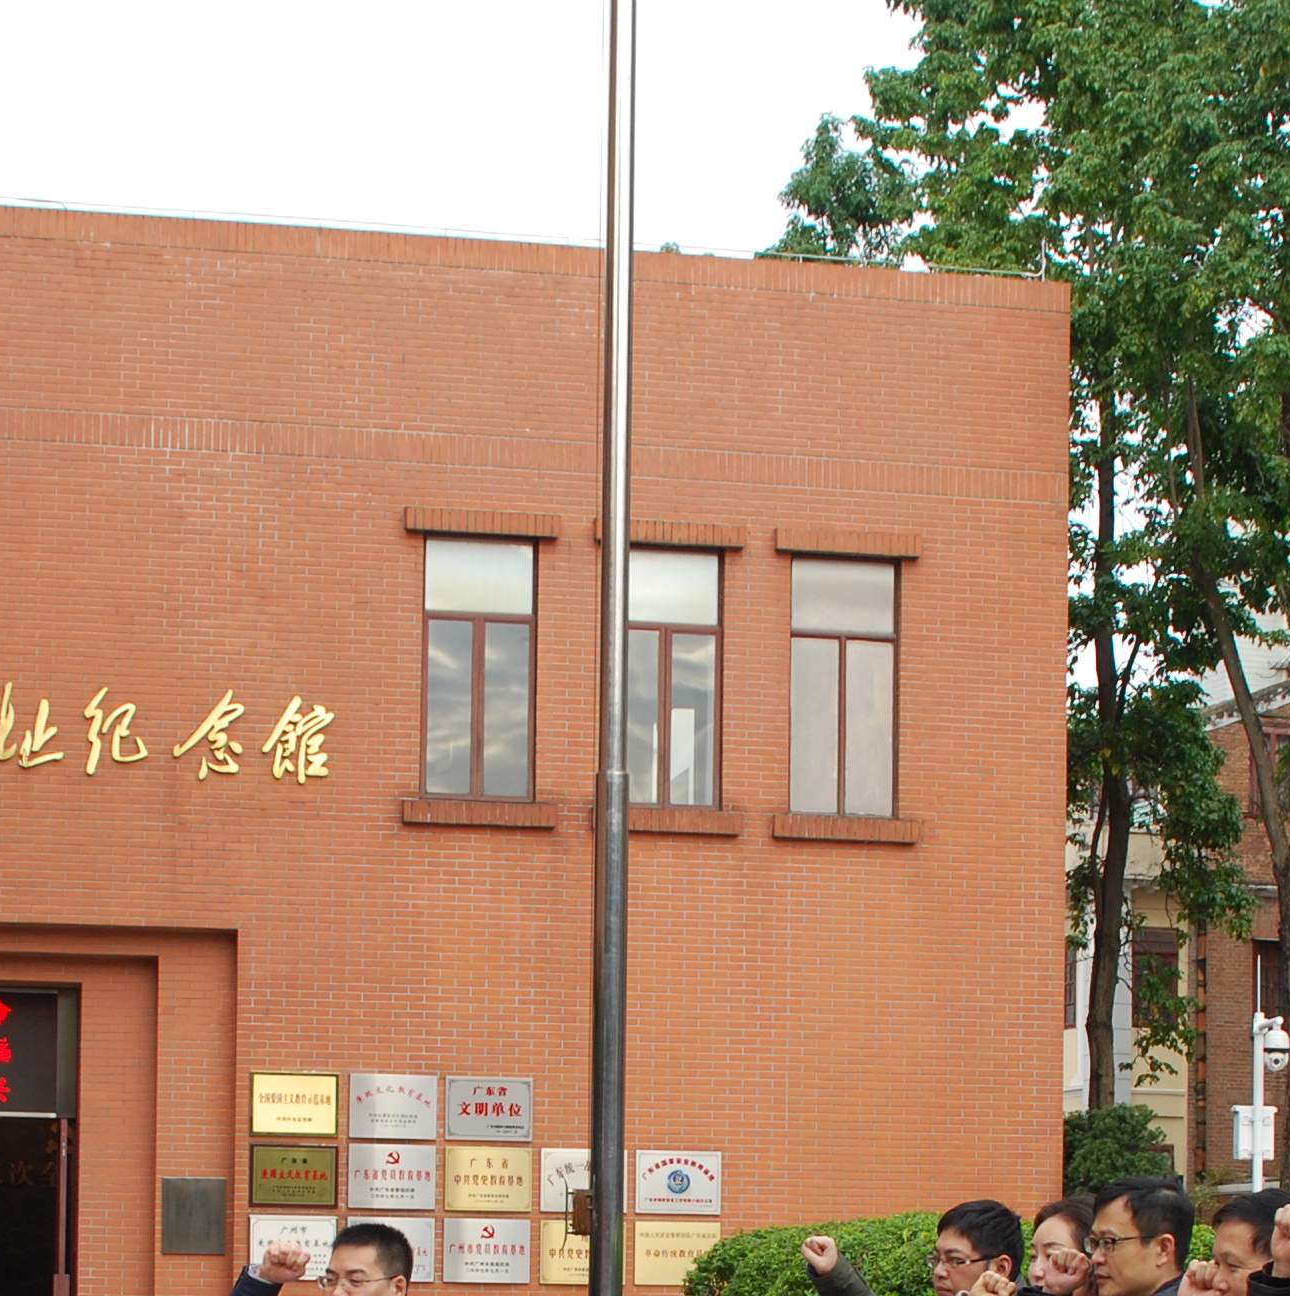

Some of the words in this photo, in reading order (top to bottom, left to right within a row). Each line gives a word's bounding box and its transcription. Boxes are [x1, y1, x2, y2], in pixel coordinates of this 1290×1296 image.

[473, 1086, 508, 1097] 广东省
[457, 1101, 522, 1117] 文明单位
[470, 1158, 509, 1169] 广东省
